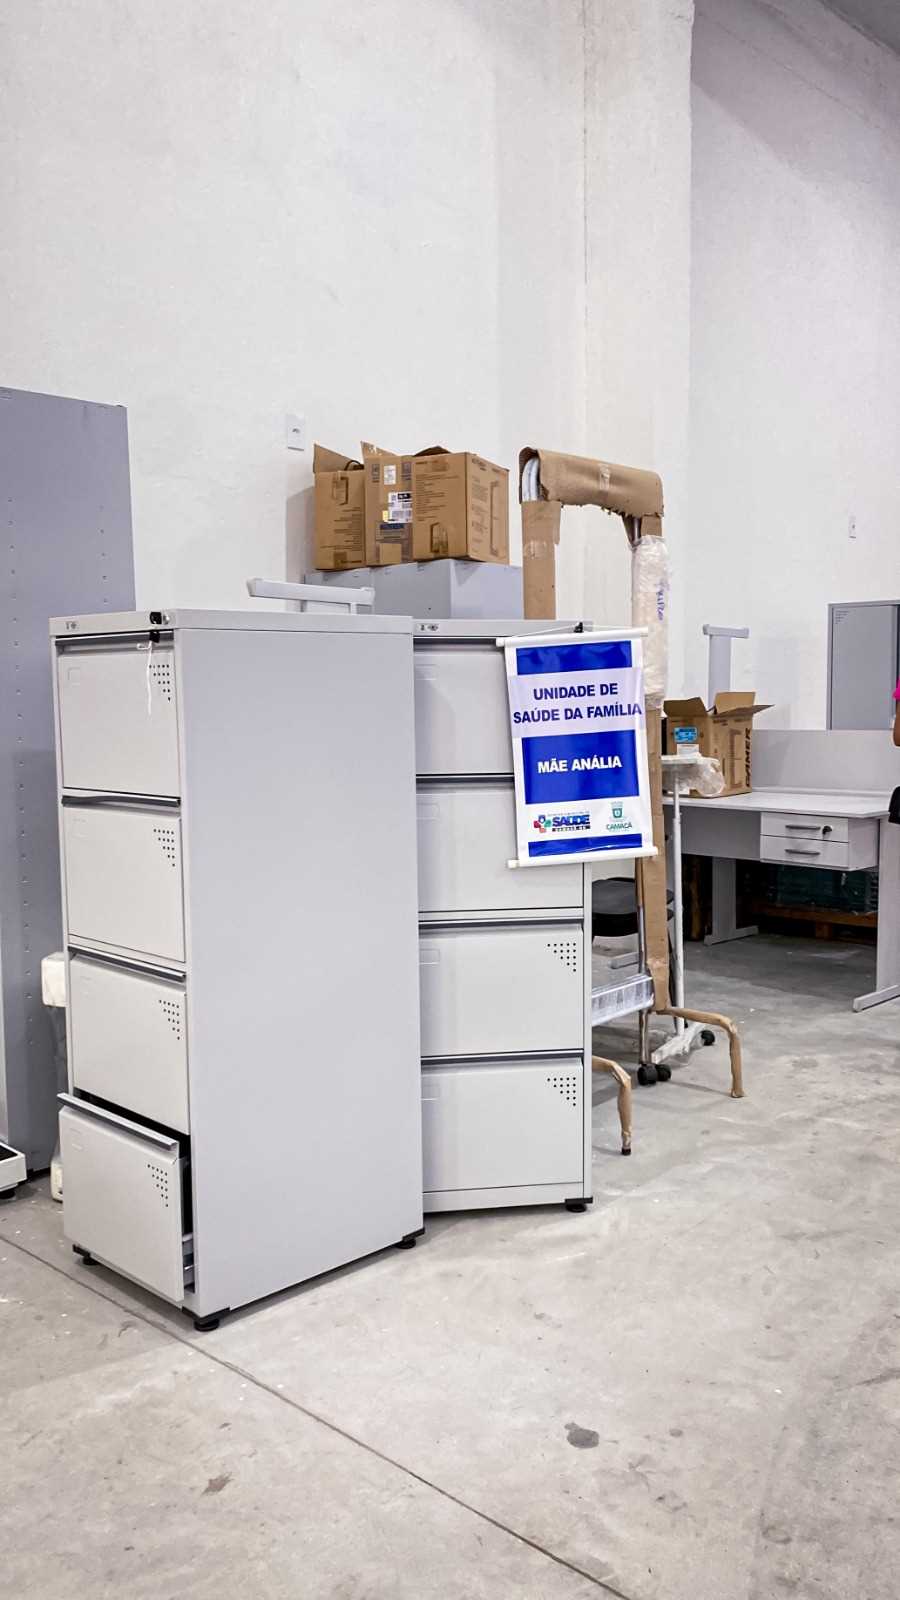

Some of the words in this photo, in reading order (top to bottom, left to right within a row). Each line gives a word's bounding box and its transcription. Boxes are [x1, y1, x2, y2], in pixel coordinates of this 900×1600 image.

[533, 685, 595, 700] UNIDADE
[600, 683, 618, 696] DE
[513, 707, 560, 723] SAÚDE
[564, 708, 583, 720] DA
[587, 701, 642, 718] FAMÍLIA
[538, 758, 568, 774] MÃE
[571, 754, 622, 770] ANÁLIA
